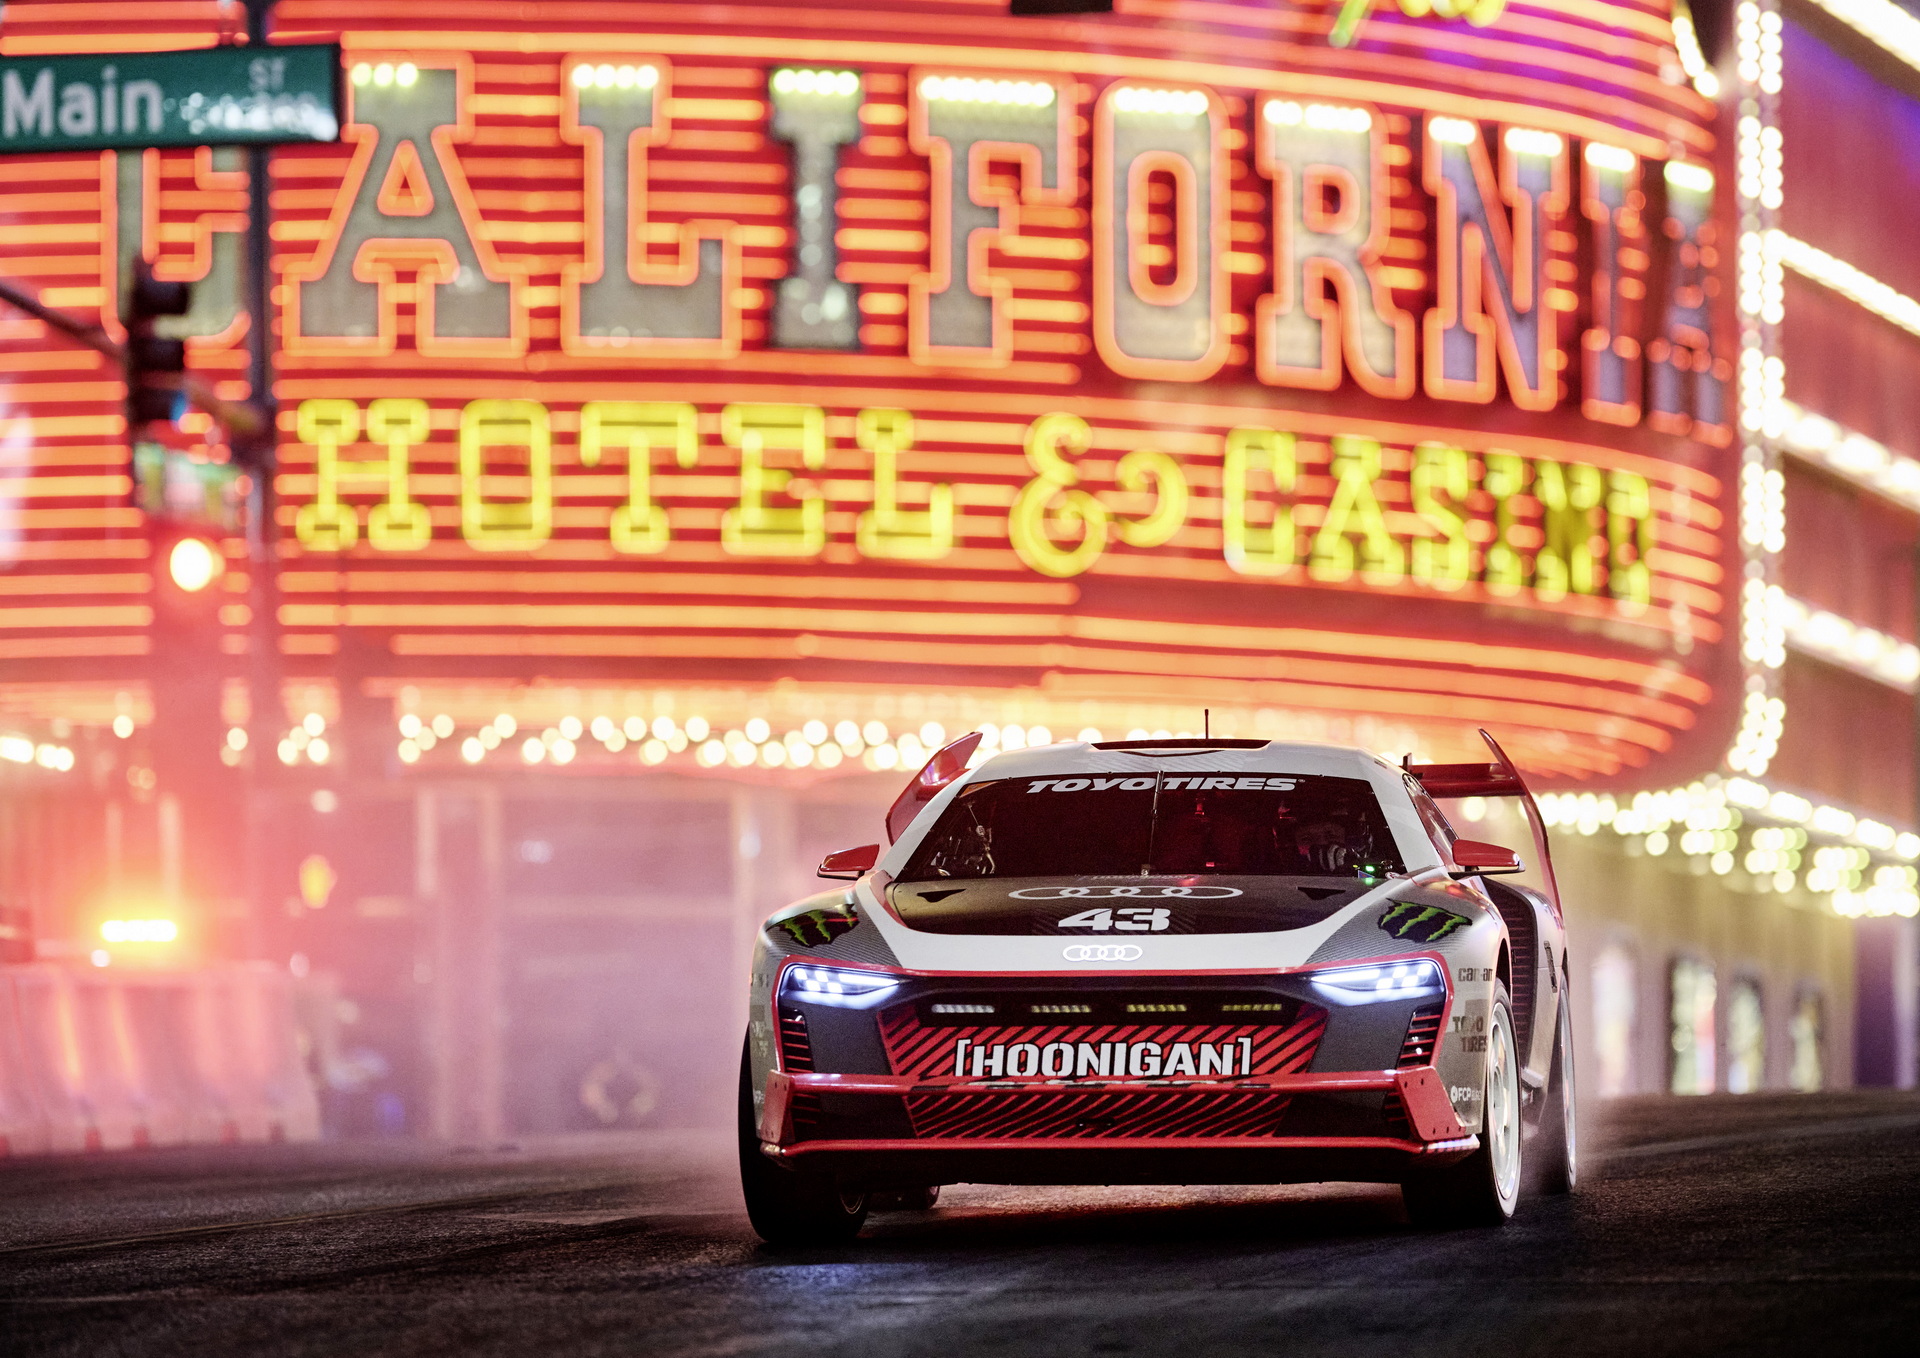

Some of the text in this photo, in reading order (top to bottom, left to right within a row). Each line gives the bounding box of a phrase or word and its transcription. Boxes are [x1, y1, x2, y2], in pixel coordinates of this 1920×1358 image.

[3, 66, 164, 138] Main
[101, 50, 1733, 448] CALIFORNIA
[296, 399, 1651, 618] HOTEL & CASINO
[1026, 777, 1297, 794] TOYO TIRES
[1057, 908, 1171, 931] 43
[1452, 1015, 1484, 1033] TOO
